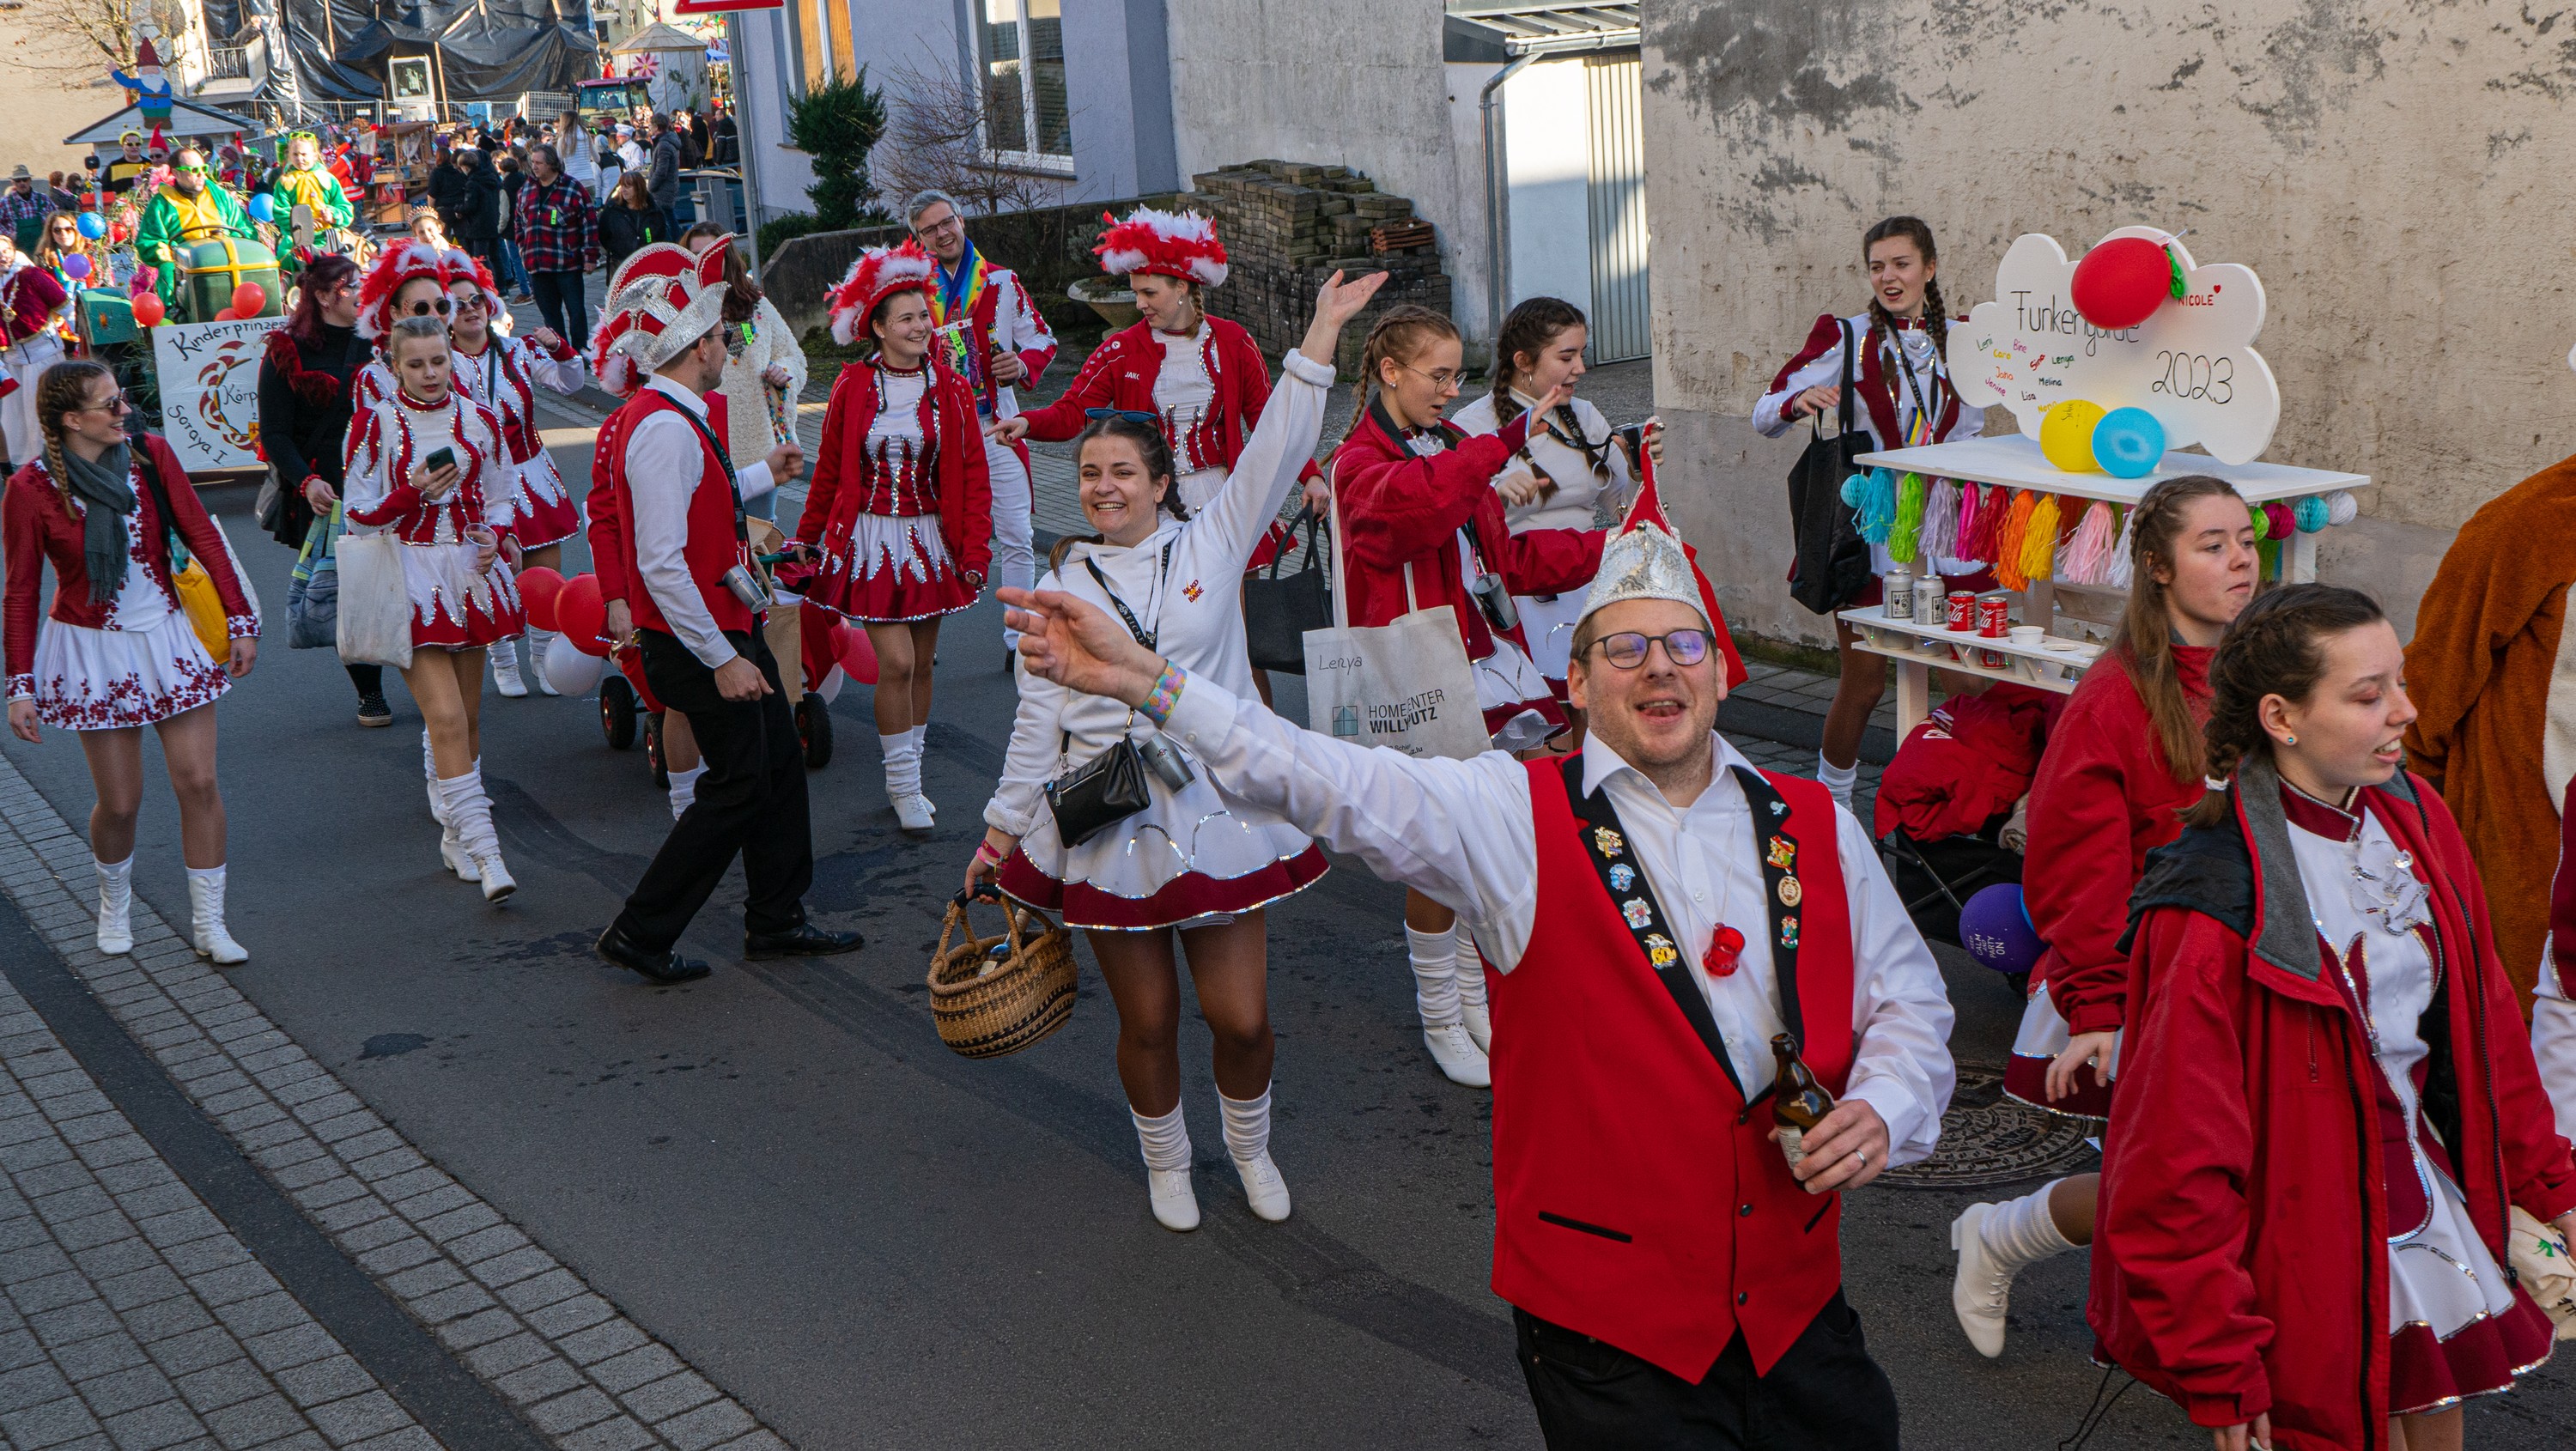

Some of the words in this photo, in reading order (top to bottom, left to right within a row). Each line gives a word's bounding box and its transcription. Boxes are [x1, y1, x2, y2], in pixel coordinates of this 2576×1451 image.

[2178, 294, 2214, 307] NICOLE
[167, 321, 285, 361] Kinderprinzes
[2013, 338, 2027, 353] Bine
[1993, 349, 2011, 360] Caro
[2029, 354, 2046, 371] Sina
[2051, 355, 2075, 368] Lenya
[2038, 377, 2063, 386] Melina
[2151, 350, 2233, 404] 2023
[1984, 376, 2006, 397] Janine
[2020, 390, 2036, 401] Lisa
[222, 384, 258, 408] Körp
[167, 404, 212, 455] Soraya
[1188, 586, 1205, 603] BABE
[1318, 654, 1363, 676] Lenya
[1369, 689, 1445, 719] HOMEENTER
[1408, 707, 1437, 726] UTZ
[1988, 936, 1996, 958] PARTY
[1996, 943, 2005, 955] ON
